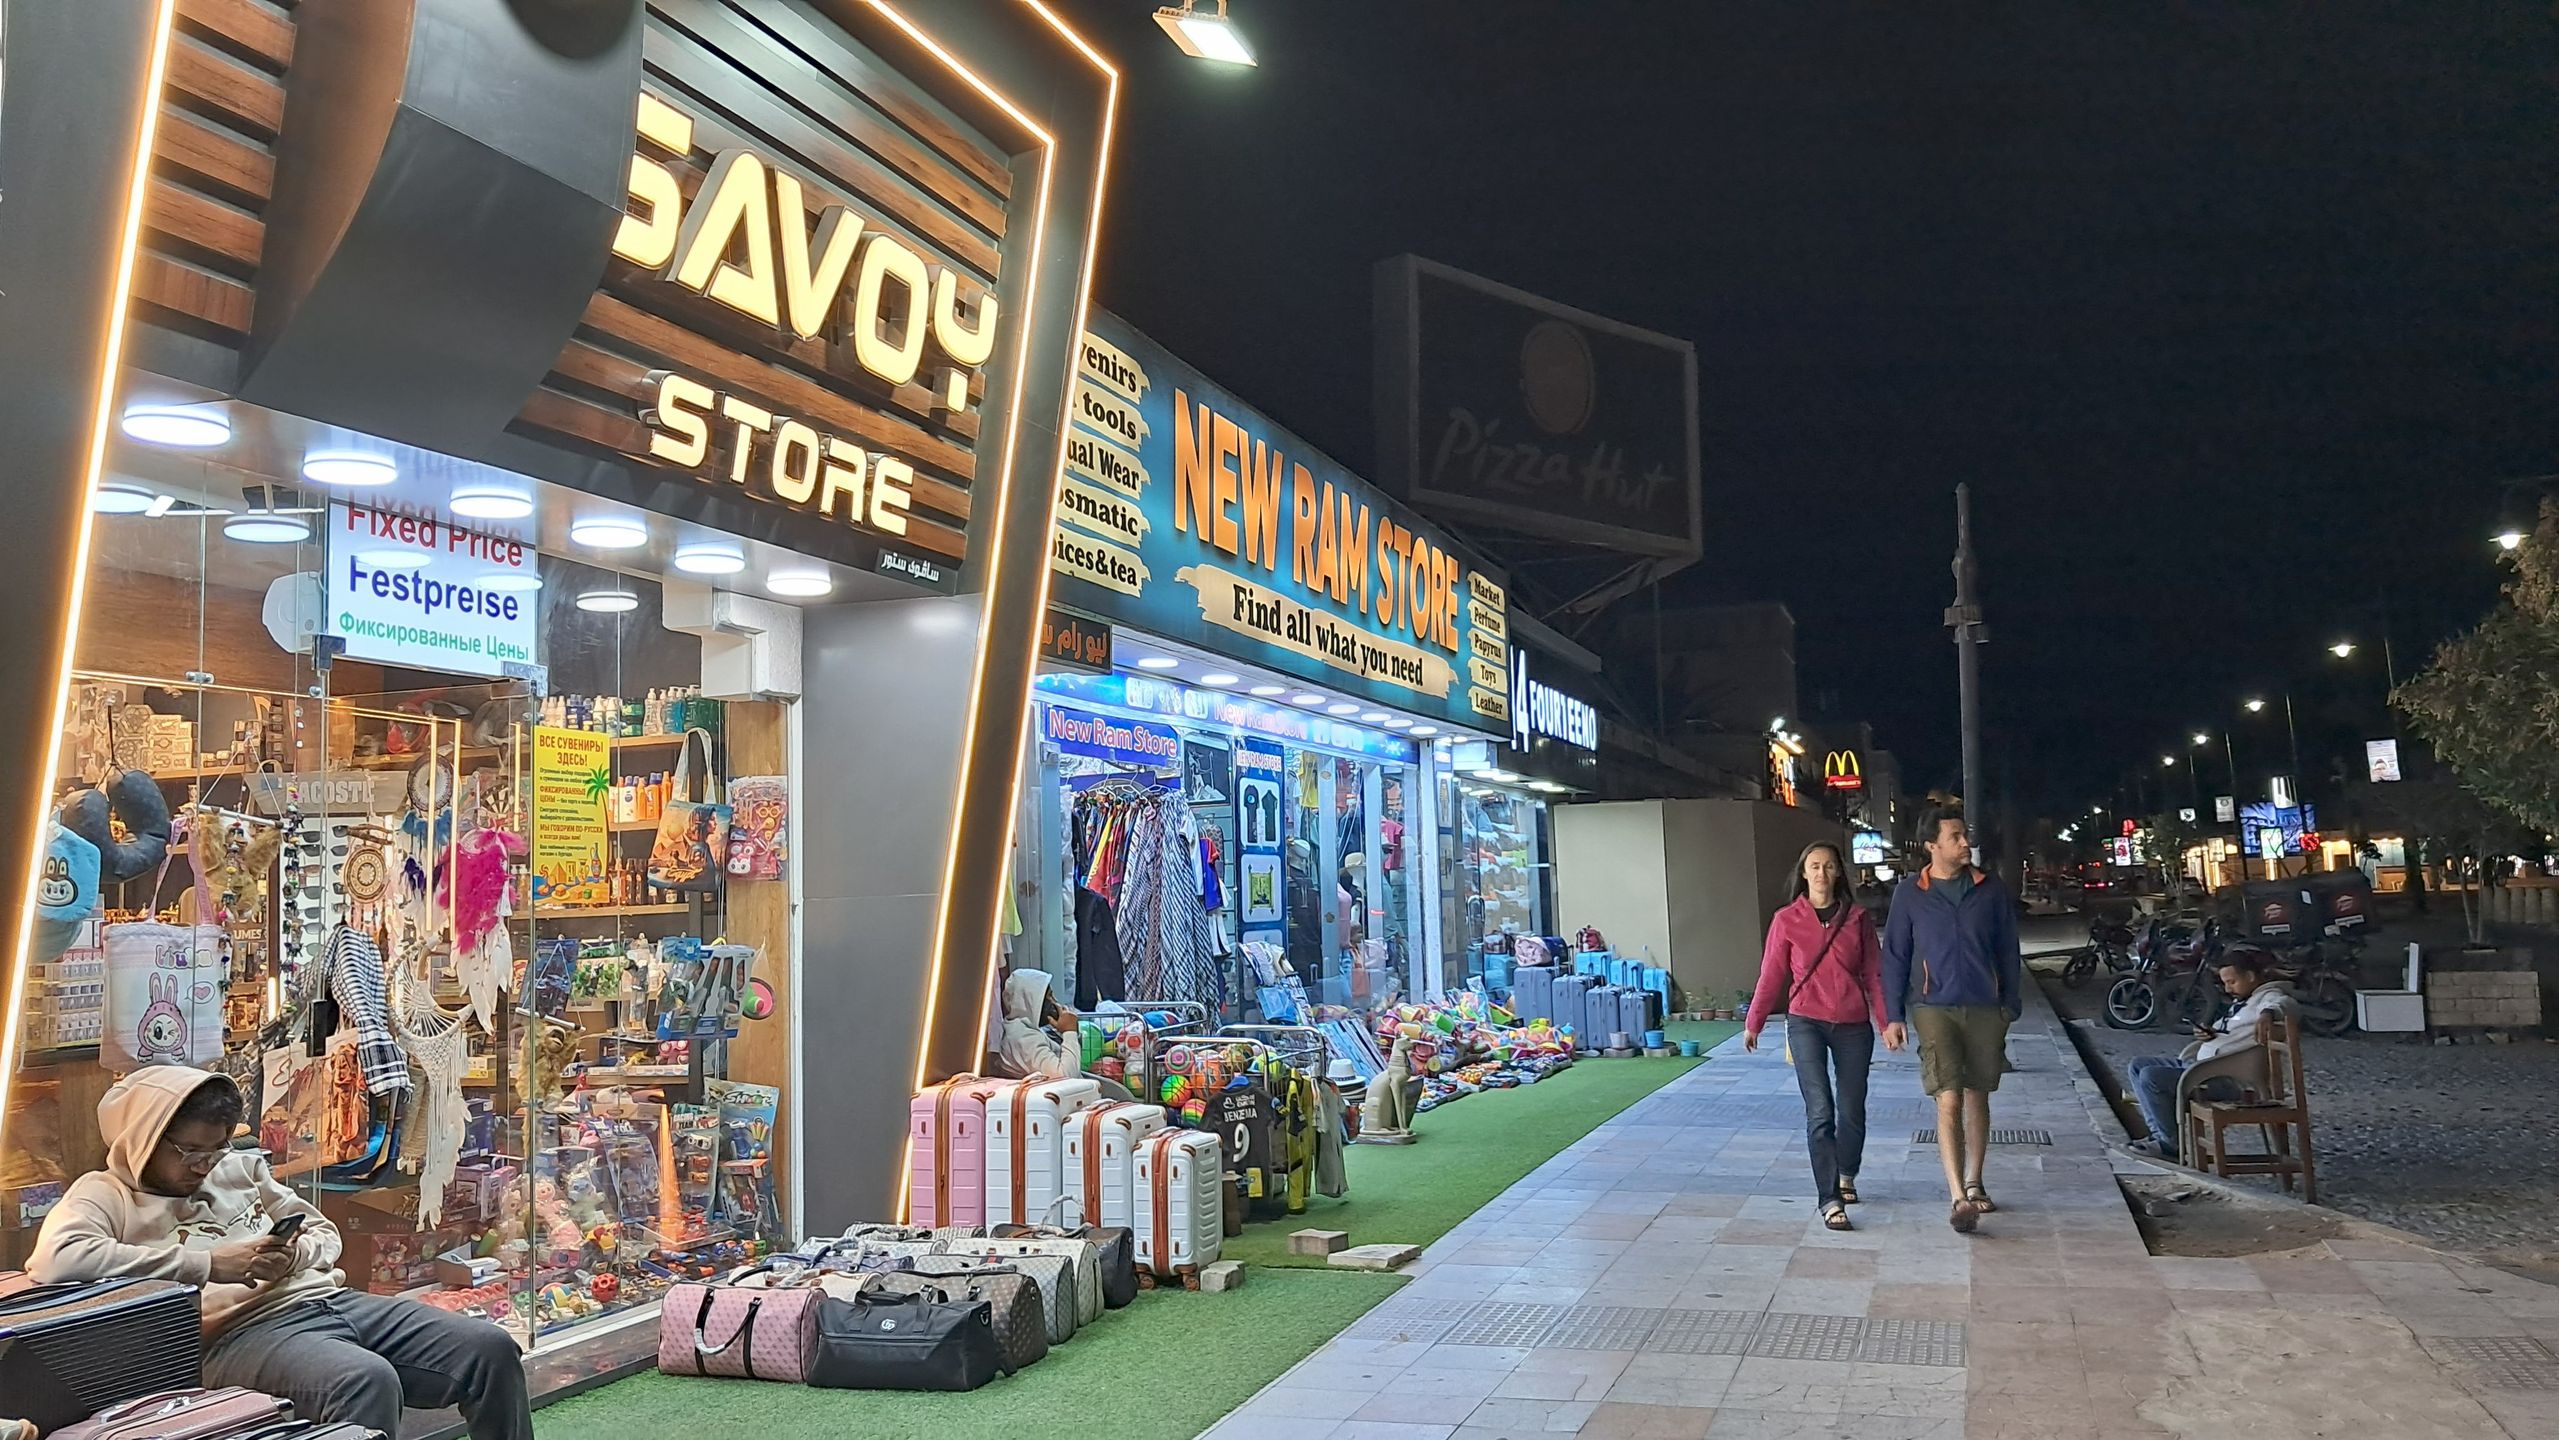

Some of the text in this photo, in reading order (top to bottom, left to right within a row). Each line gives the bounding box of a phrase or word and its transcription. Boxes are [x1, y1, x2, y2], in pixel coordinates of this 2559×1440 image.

[611, 91, 999, 413] SAVOY
[1083, 391, 1137, 440] tools
[648, 371, 915, 537] STORE
[1098, 446, 1140, 491] Wear
[1431, 405, 1677, 510] Pizza Hut
[347, 492, 523, 567] Fixed Price
[1174, 387, 1460, 653] NEW RAM STORE
[350, 554, 519, 621] Festpreise
[1474, 578, 1500, 606] Market
[338, 611, 529, 662] Фиксированные Цены
[1058, 621, 1082, 660] رام
[1233, 583, 1424, 687] Find all what you need
[1474, 606, 1501, 634] Perfume
[1474, 633, 1502, 658] Papyrus
[1480, 664, 1497, 686] Toys
[1475, 692, 1503, 715] Leather
[539, 735, 604, 753] ВСЕ СУВЕНИРЫ
[1049, 709, 1178, 758] New Ram Store
[557, 752, 588, 767] ЗДЕСЬ!
[1233, 1122, 1250, 1163] 9
